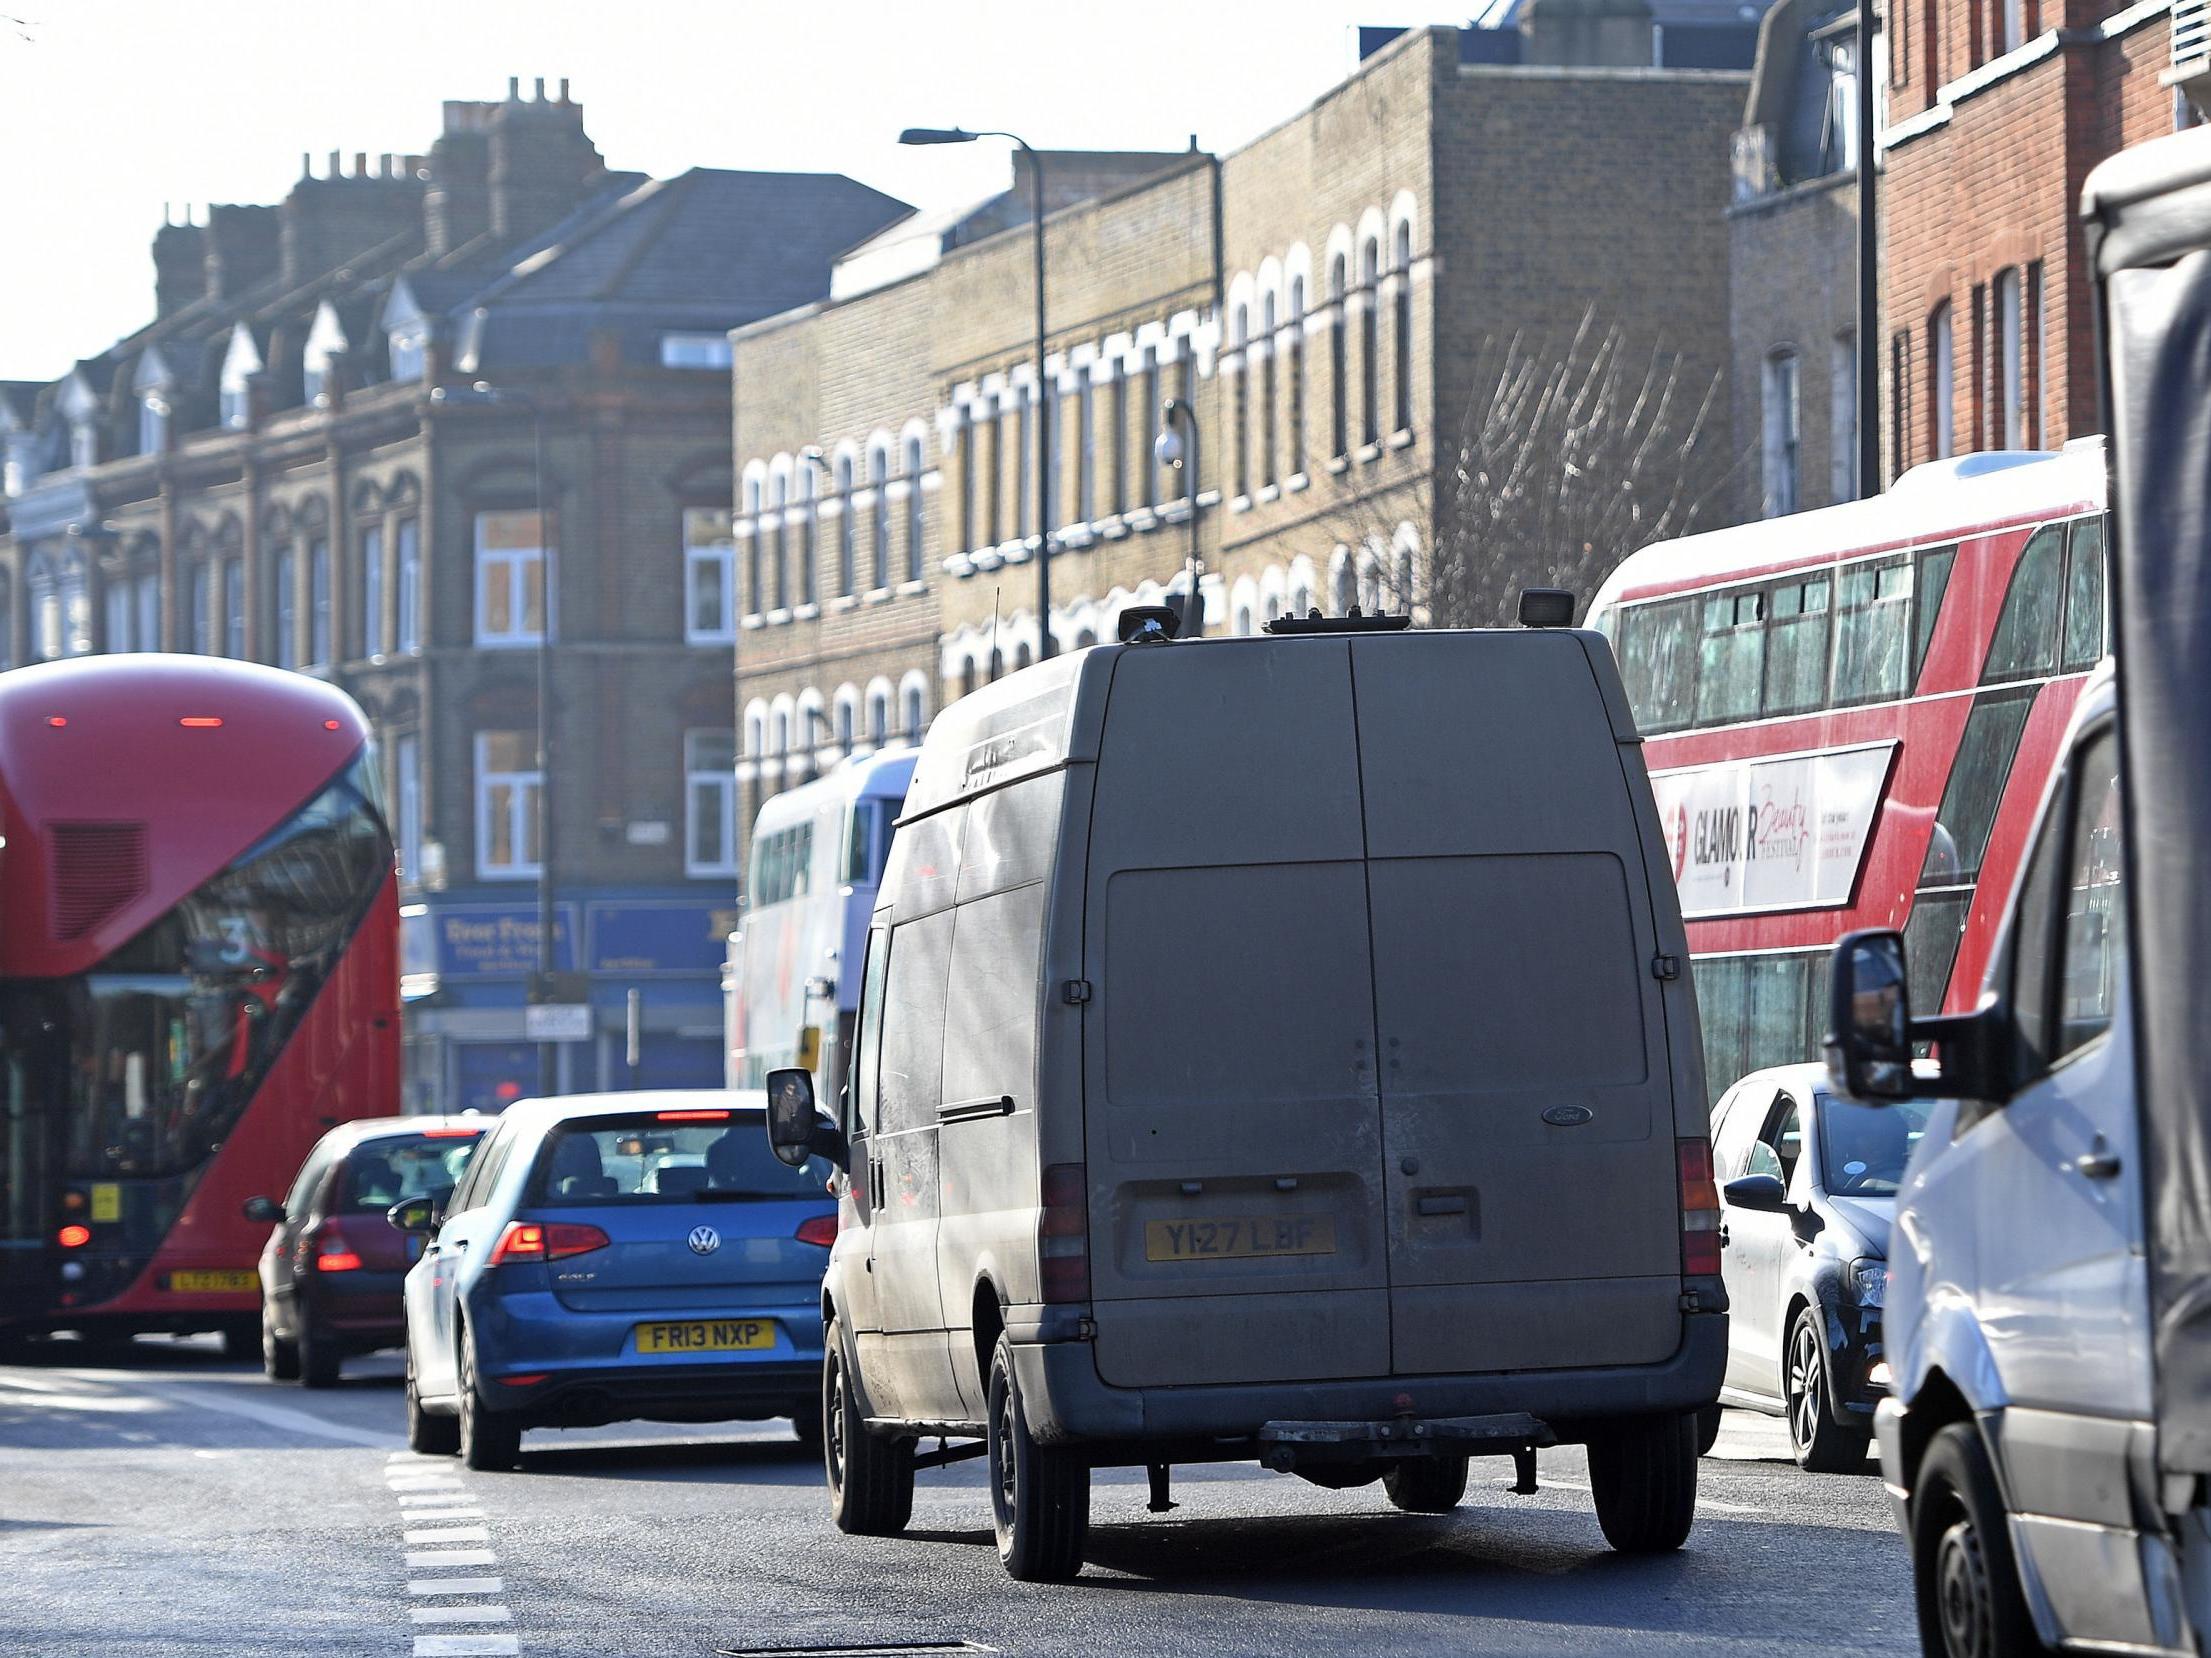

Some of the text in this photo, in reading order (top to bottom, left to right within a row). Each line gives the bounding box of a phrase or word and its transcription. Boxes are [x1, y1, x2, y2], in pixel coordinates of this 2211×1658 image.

[1694, 804, 1757, 865] GLAMOR
[652, 1322, 760, 1349] FR13 NXP
